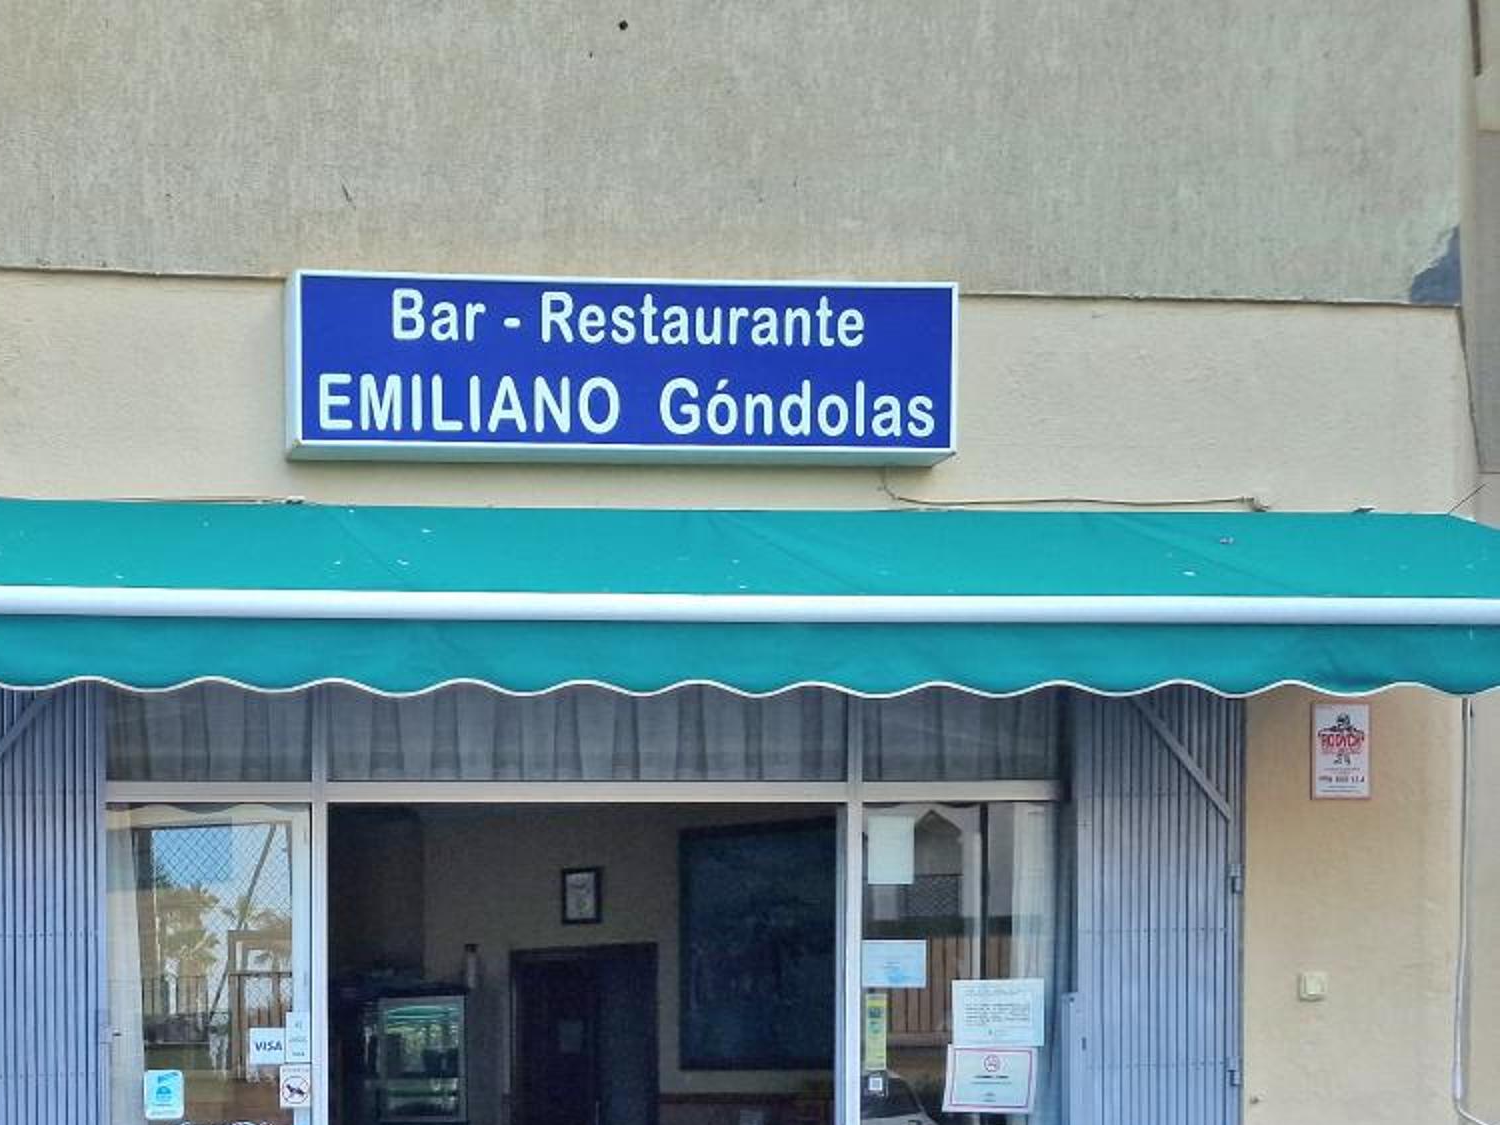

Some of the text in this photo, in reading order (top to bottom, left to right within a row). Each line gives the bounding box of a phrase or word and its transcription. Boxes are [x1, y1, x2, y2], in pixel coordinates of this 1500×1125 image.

[391, 287, 866, 348] Bar - Restaurante
[318, 372, 936, 439] EMILIANO Góndolas
[254, 1041, 283, 1052] VISA
